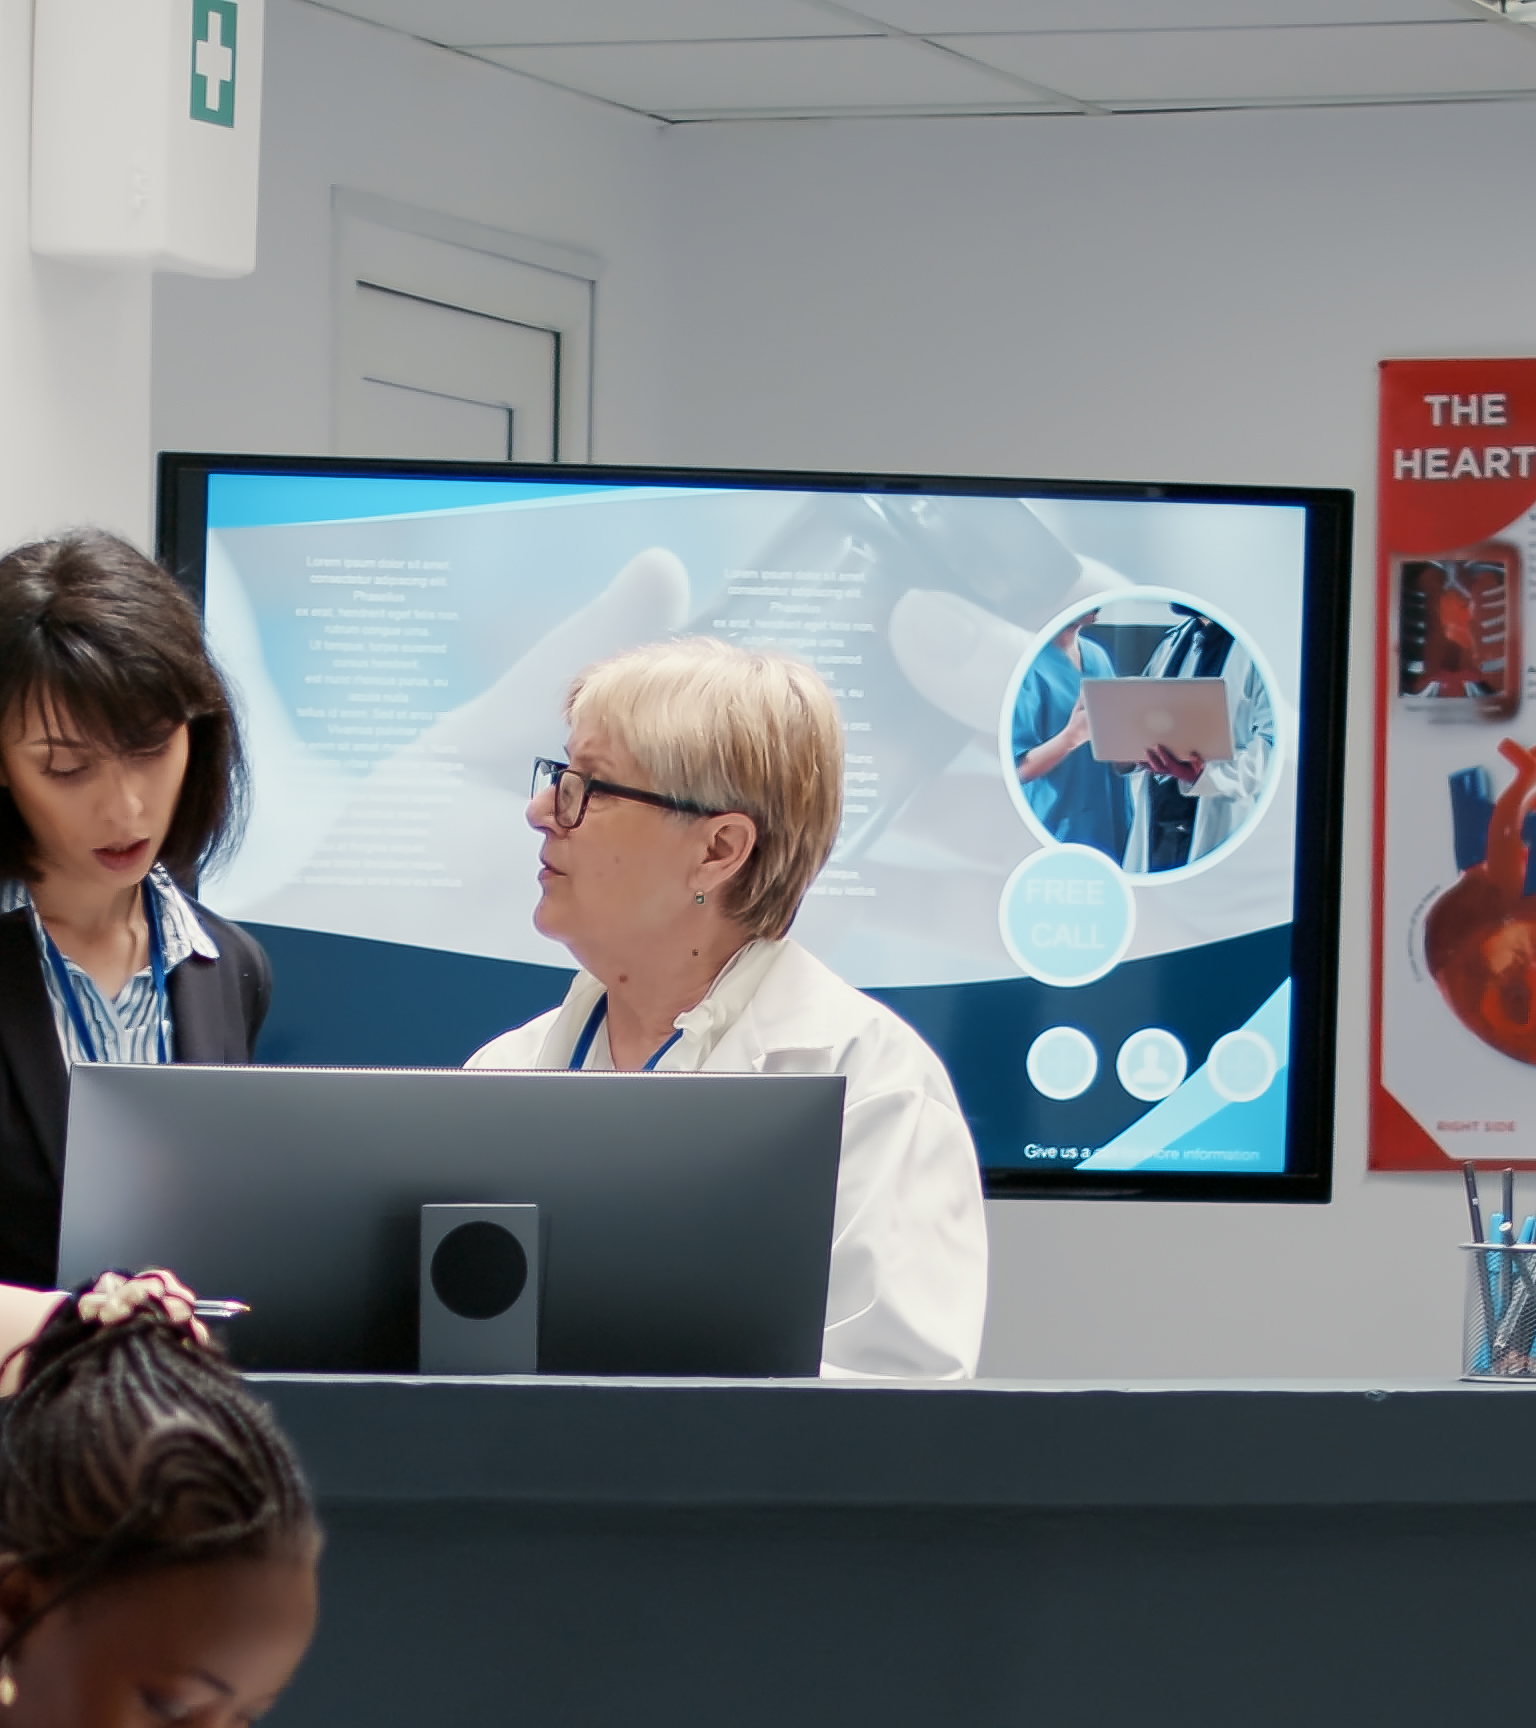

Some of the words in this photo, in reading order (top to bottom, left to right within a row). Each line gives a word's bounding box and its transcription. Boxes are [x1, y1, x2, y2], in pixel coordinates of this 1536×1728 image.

[1423, 393, 1507, 426] THE
[306, 556, 341, 567] Lorem
[344, 559, 376, 569] ipsum
[378, 558, 405, 569] dolor
[408, 560, 421, 569] sit
[1026, 879, 1105, 905] FREE
[1032, 922, 1106, 949] CALL
[1436, 1121, 1480, 1133] RIGHT
[1484, 1121, 1516, 1133] SIDE
[1023, 1143, 1057, 1159] Give
[1060, 1146, 1078, 1159] us
[1080, 1147, 1092, 1159] a
[1183, 1147, 1260, 1160] information
